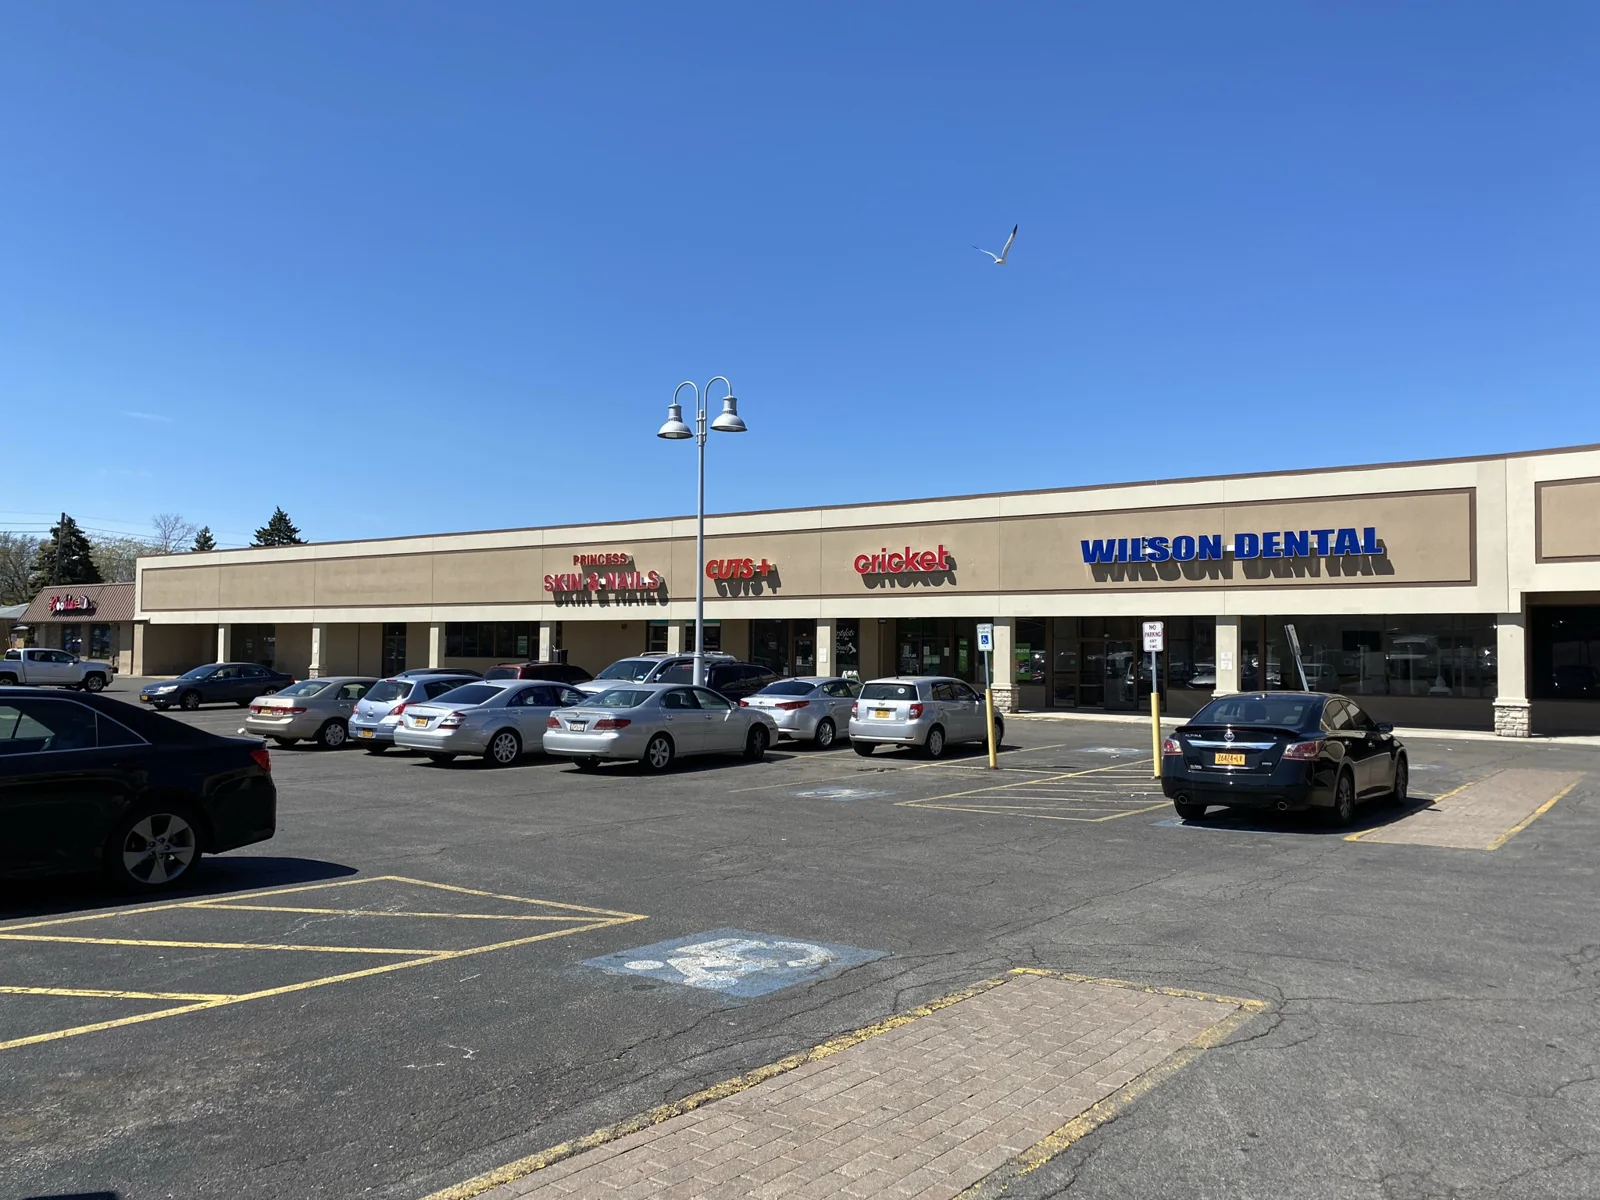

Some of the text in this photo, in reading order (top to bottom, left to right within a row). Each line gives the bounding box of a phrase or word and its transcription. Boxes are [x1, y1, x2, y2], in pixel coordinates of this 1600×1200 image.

[1080, 526, 1384, 563] WILSON DENTAL
[573, 553, 628, 566] PRINCESS
[705, 558, 753, 579] CUTS
[854, 544, 949, 574] cricket
[544, 570, 660, 592] SKIN & NAILS
